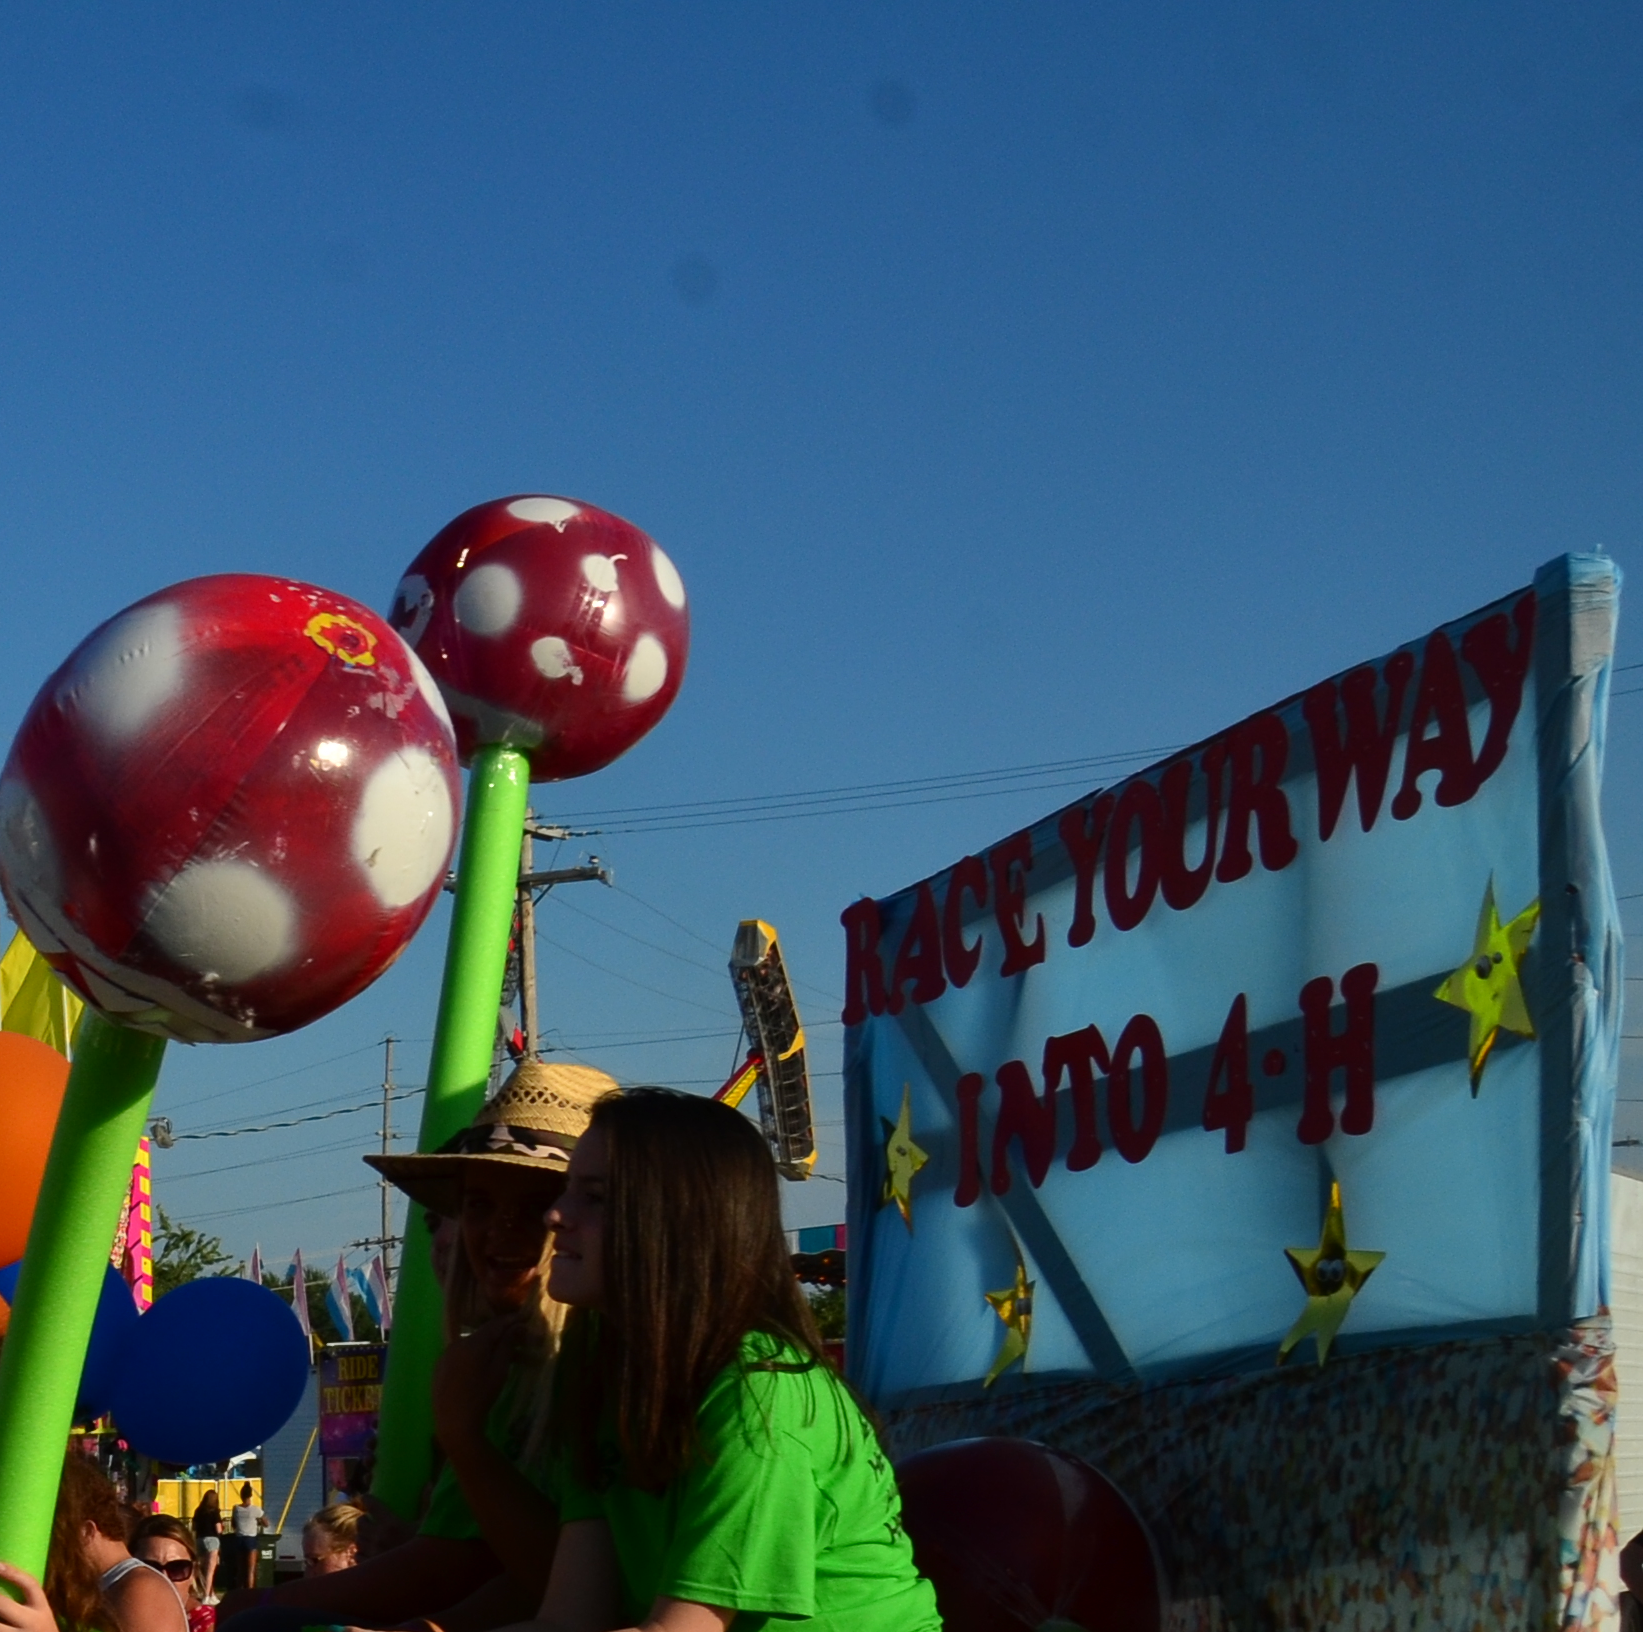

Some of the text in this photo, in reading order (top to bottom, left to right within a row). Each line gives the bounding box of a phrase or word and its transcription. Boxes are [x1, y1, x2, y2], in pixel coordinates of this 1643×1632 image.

[839, 590, 1537, 1027] RACE YOUR WAY
[953, 1014, 1169, 1208] INTO
[337, 1355, 379, 1380] RIDE
